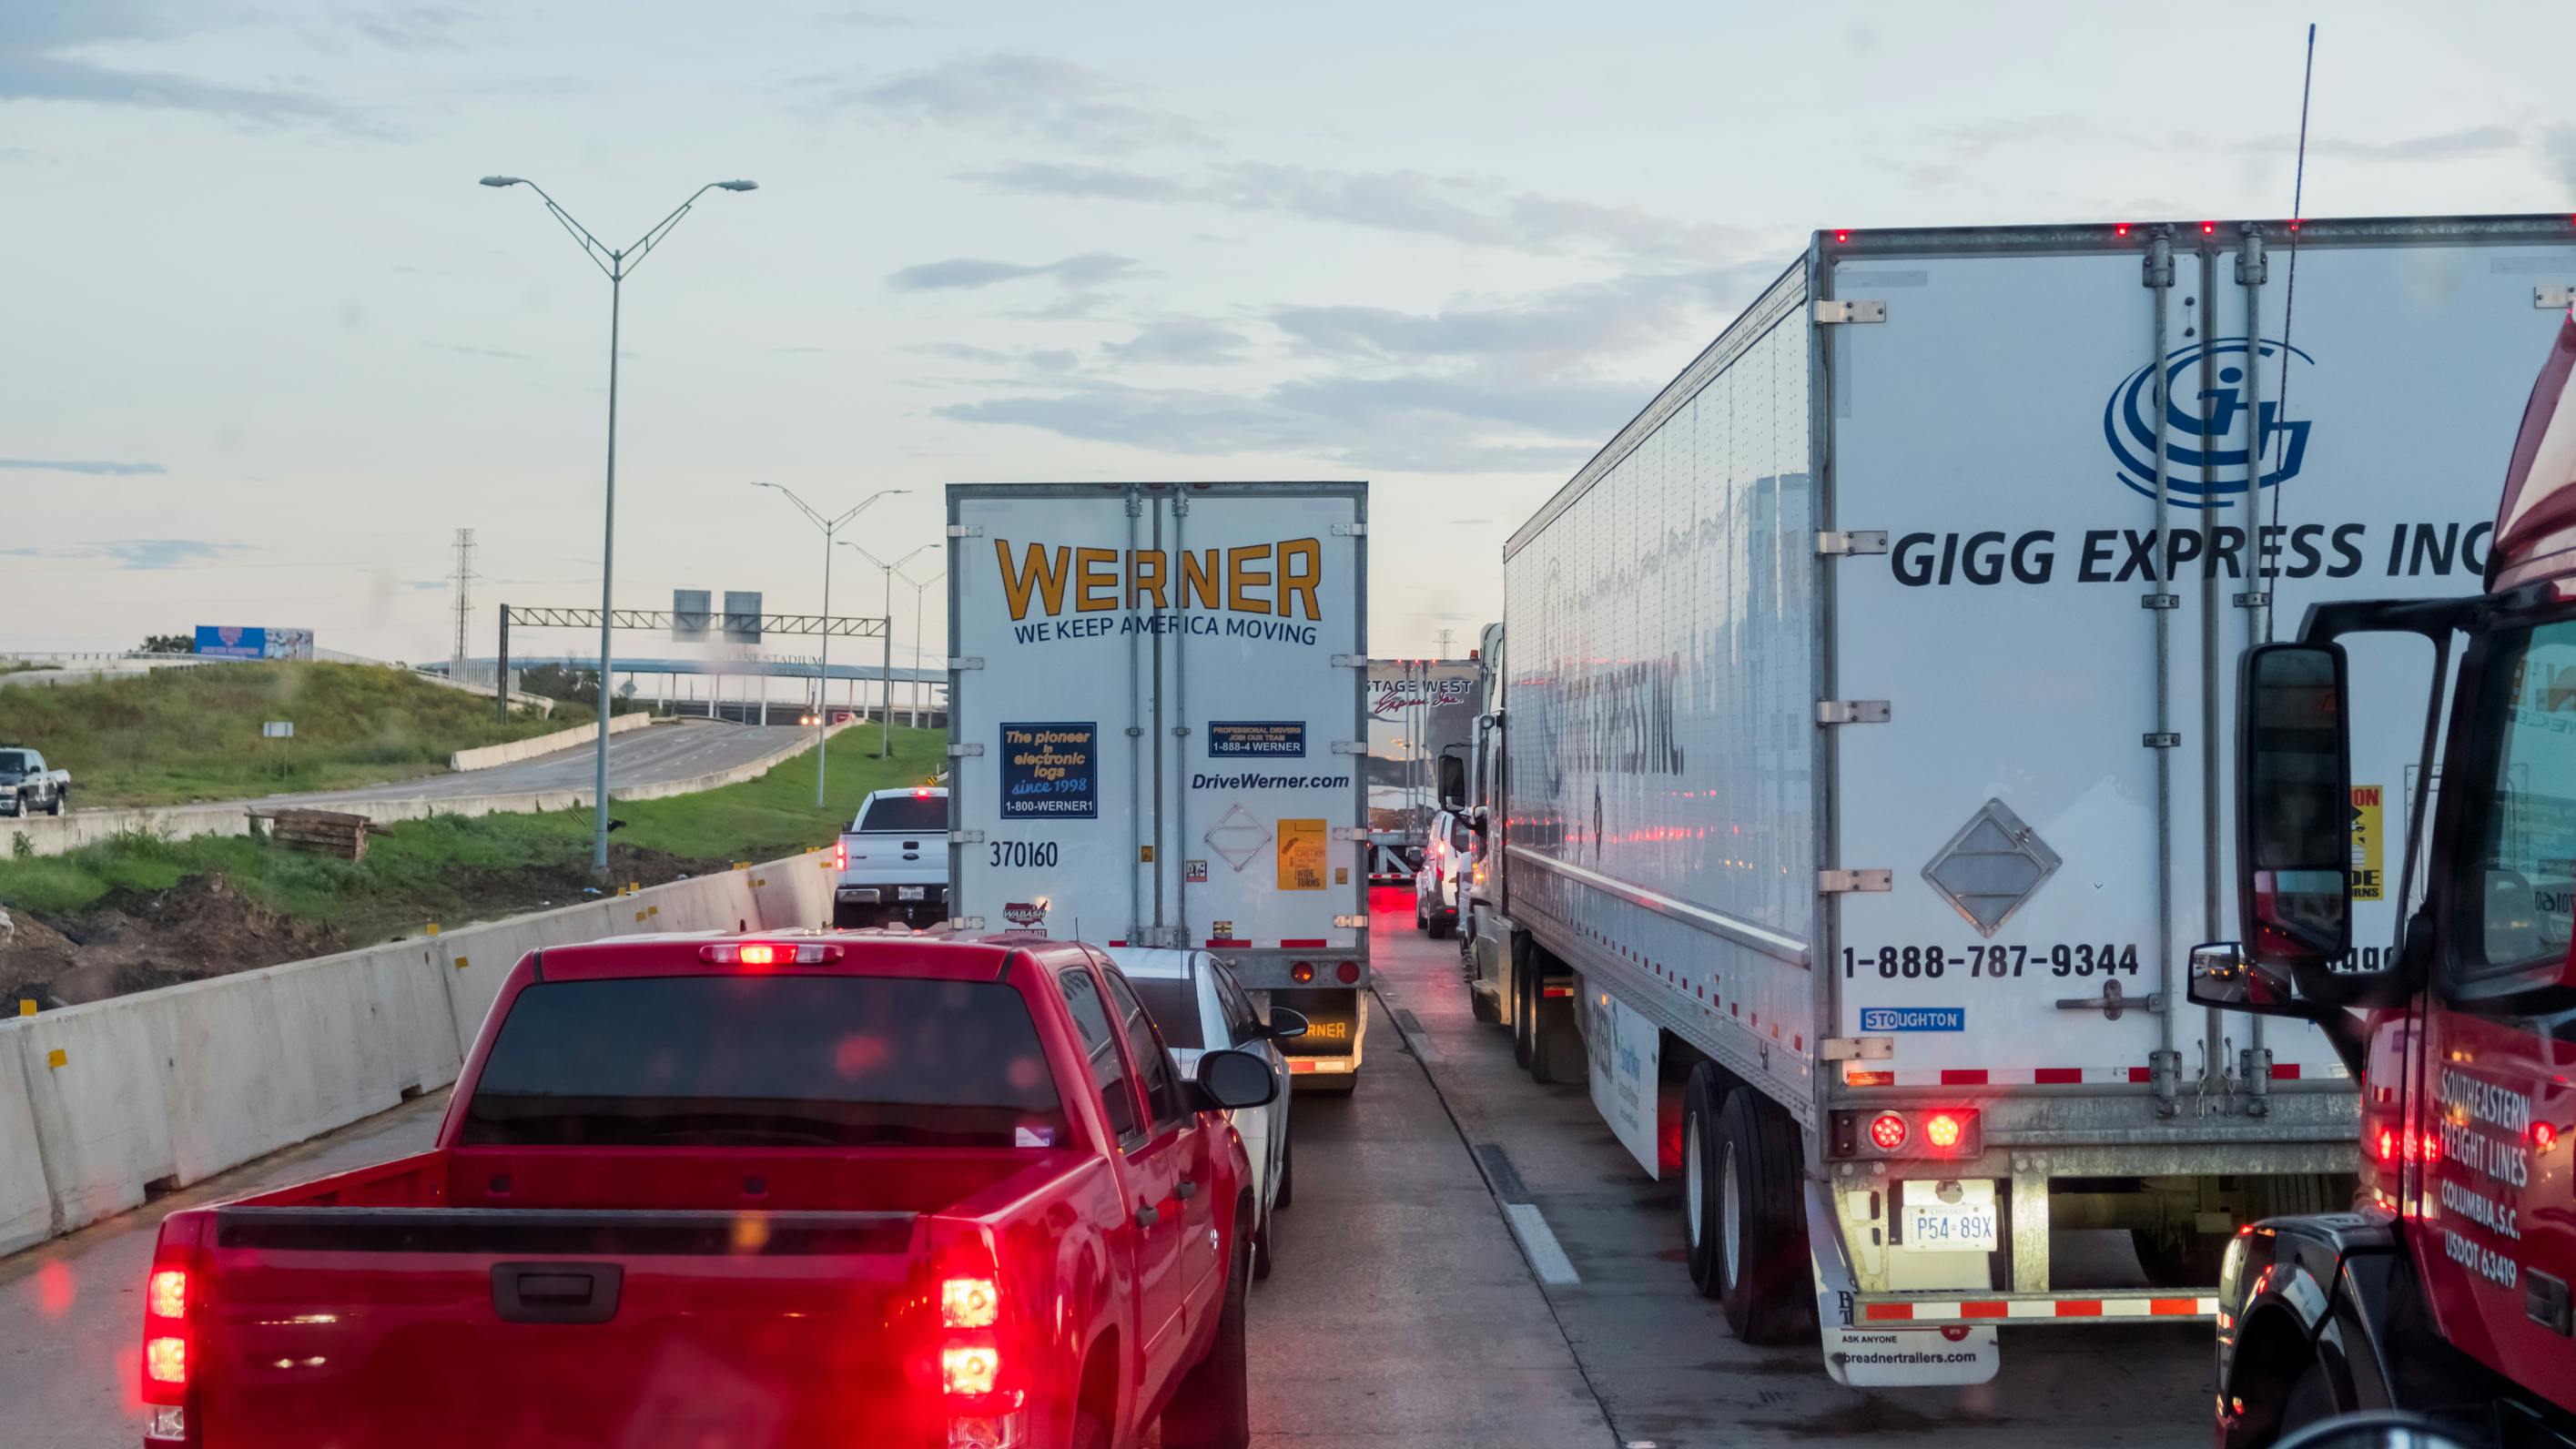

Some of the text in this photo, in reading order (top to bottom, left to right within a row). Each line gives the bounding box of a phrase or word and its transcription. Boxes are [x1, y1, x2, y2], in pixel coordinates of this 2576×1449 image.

[1891, 530, 2054, 587] GIGG
[2078, 523, 2365, 583] EXPRESS
[994, 537, 1322, 622] WERNER
[1015, 615, 1317, 646] WE KEEP AMERICA MOVING
[764, 654, 822, 665] STADIUM
[1422, 680, 1472, 693] WEST
[1374, 689, 1428, 714] Expess
[1006, 731, 1091, 746] The pioneer
[1213, 742, 1301, 752] 1-888-4 WERNER
[1014, 752, 1085, 765] electronic
[1034, 765, 1065, 780] logs
[1012, 777, 1087, 795] since 1998
[1192, 774, 1349, 789] DriveWerner.com
[1005, 800, 1093, 812] 1-800-WERNER1
[989, 841, 1059, 867] 370160
[1004, 910, 1046, 918] WABASH
[1842, 944, 2138, 978] 1-888-787-9344
[1866, 1010, 1958, 1028] STOUGHTON
[2440, 1067, 2530, 1136] SOUTHEASTERN
[2439, 1119, 2528, 1188] FREIGHT LINES
[2445, 1230, 2517, 1289] USDOT 63419
[1841, 1335, 1897, 1343] ASK ANYONE
[1843, 1352, 1976, 1363] breadnertrailers.com
